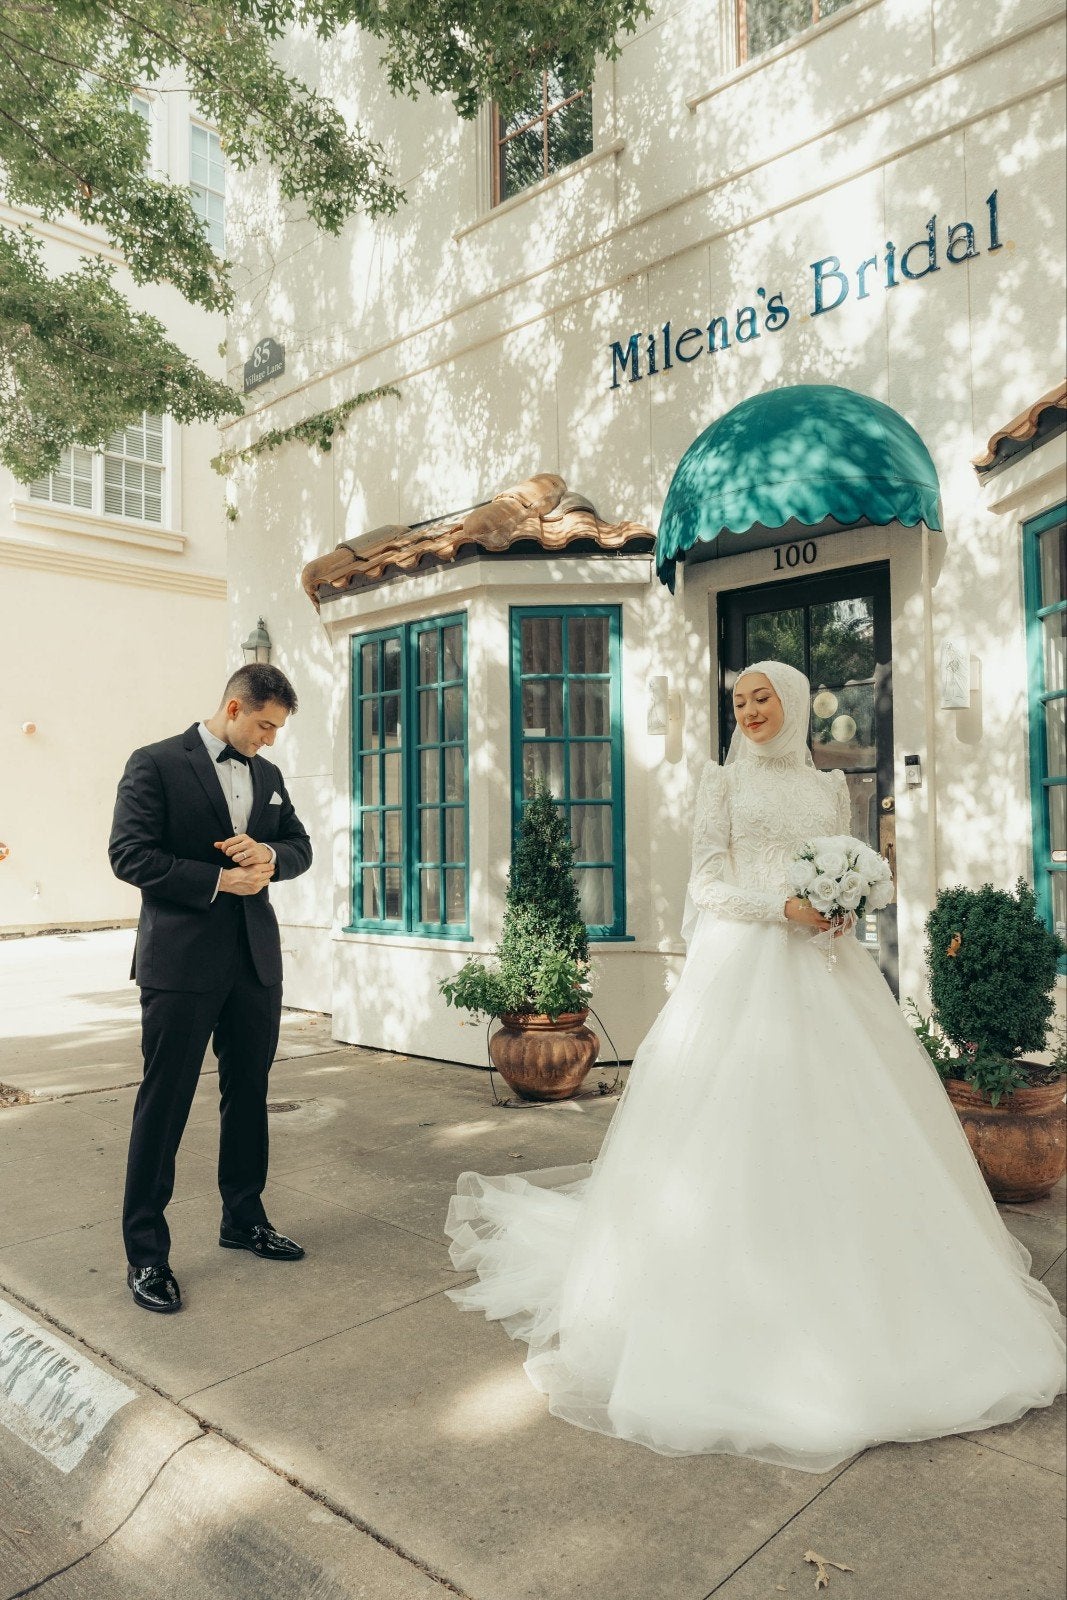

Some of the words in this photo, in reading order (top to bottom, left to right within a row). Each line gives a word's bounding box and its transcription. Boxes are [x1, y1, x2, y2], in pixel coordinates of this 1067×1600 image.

[609, 287, 790, 389] Milena's
[809, 189, 1003, 317] Bridal
[253, 341, 270, 368] 85
[266, 362, 283, 376] Lane
[773, 541, 817, 571] 100
